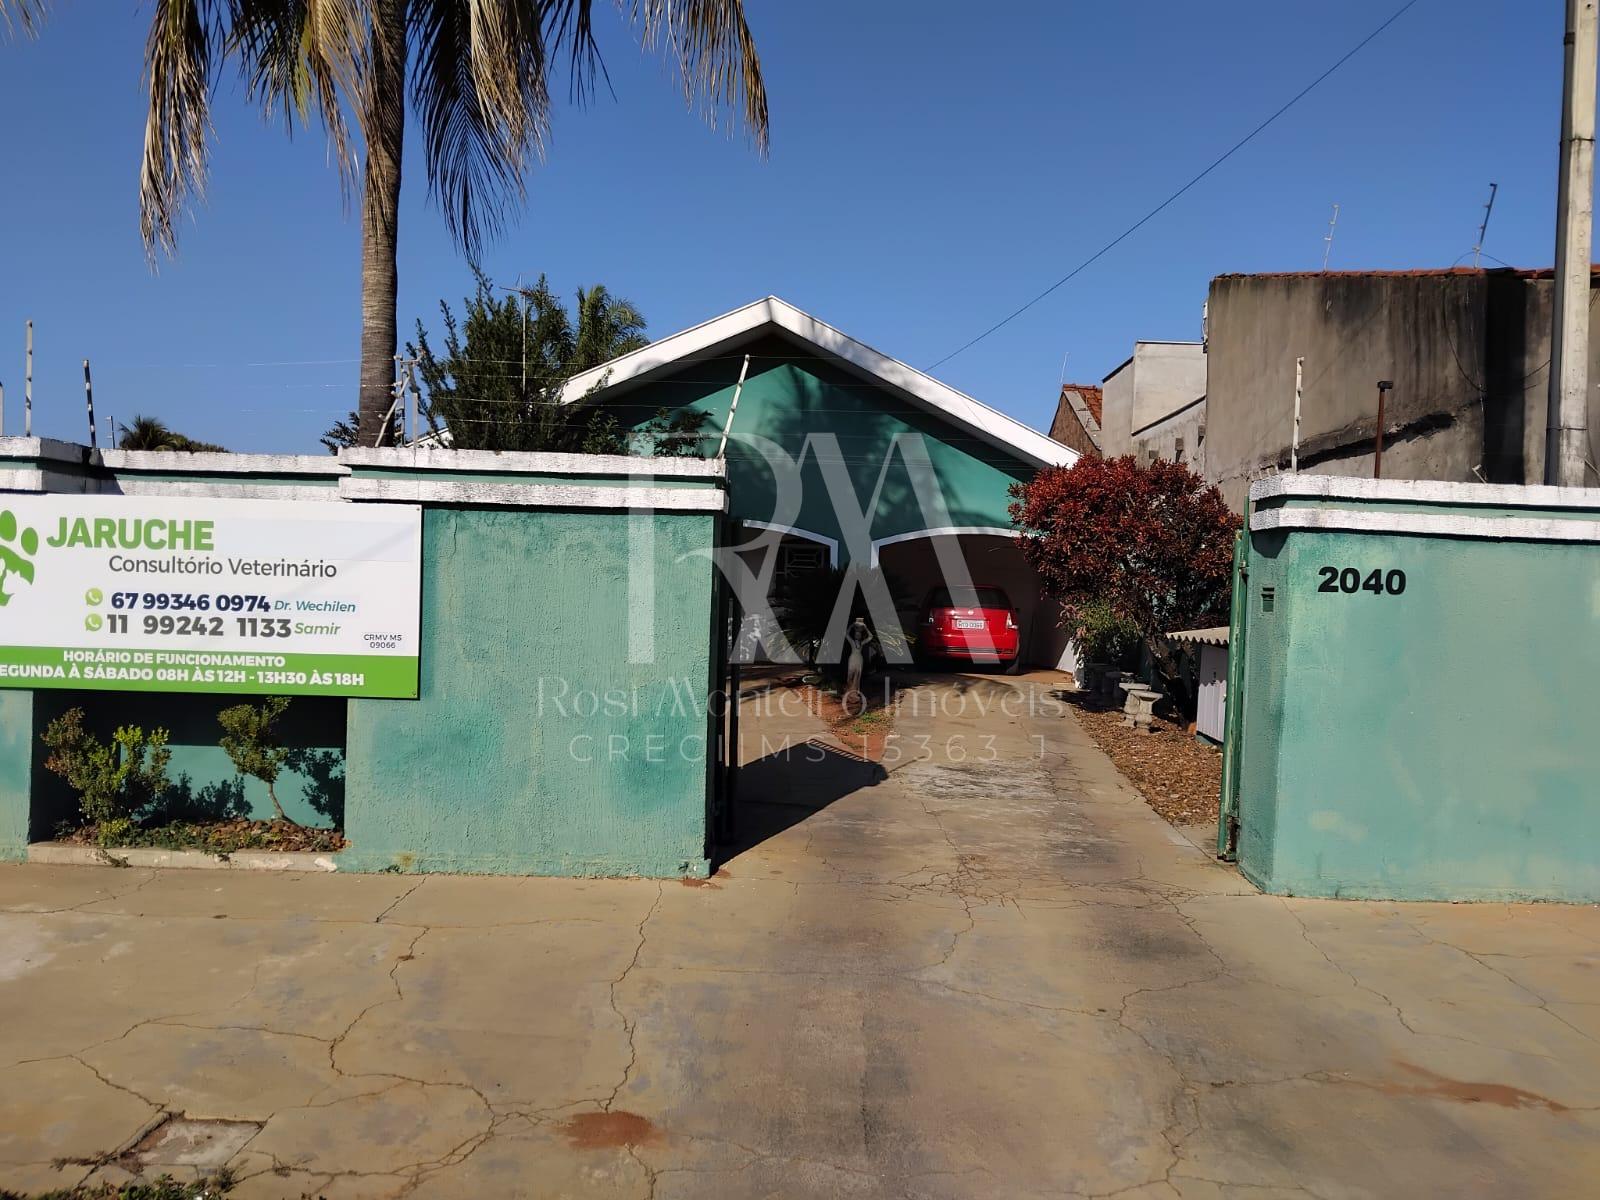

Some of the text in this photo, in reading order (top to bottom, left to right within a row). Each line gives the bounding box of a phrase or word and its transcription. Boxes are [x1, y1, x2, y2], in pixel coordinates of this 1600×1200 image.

[46, 516, 214, 551] JARUCHE
[108, 555, 337, 578] Consultório Veterinário
[1317, 565, 1407, 595] 2040
[111, 592, 356, 613] 67 99346 0974 Dr. Wechilen
[106, 614, 341, 638] 11 99242 1133 Samir
[363, 634, 402, 642] CRMV MS
[369, 641, 396, 649] 09066
[63, 649, 286, 668] HORÁRIO DE FUNCIONAMENTO
[68, 663, 81, 679] À
[84, 664, 154, 681] SÁBADO
[156, 668, 189, 681] 08H
[191, 667, 215, 682] ÀS
[217, 671, 246, 683] 12H
[257, 671, 307, 685] 13H30
[309, 670, 333, 685] ÀS
[335, 673, 365, 686] 18H
